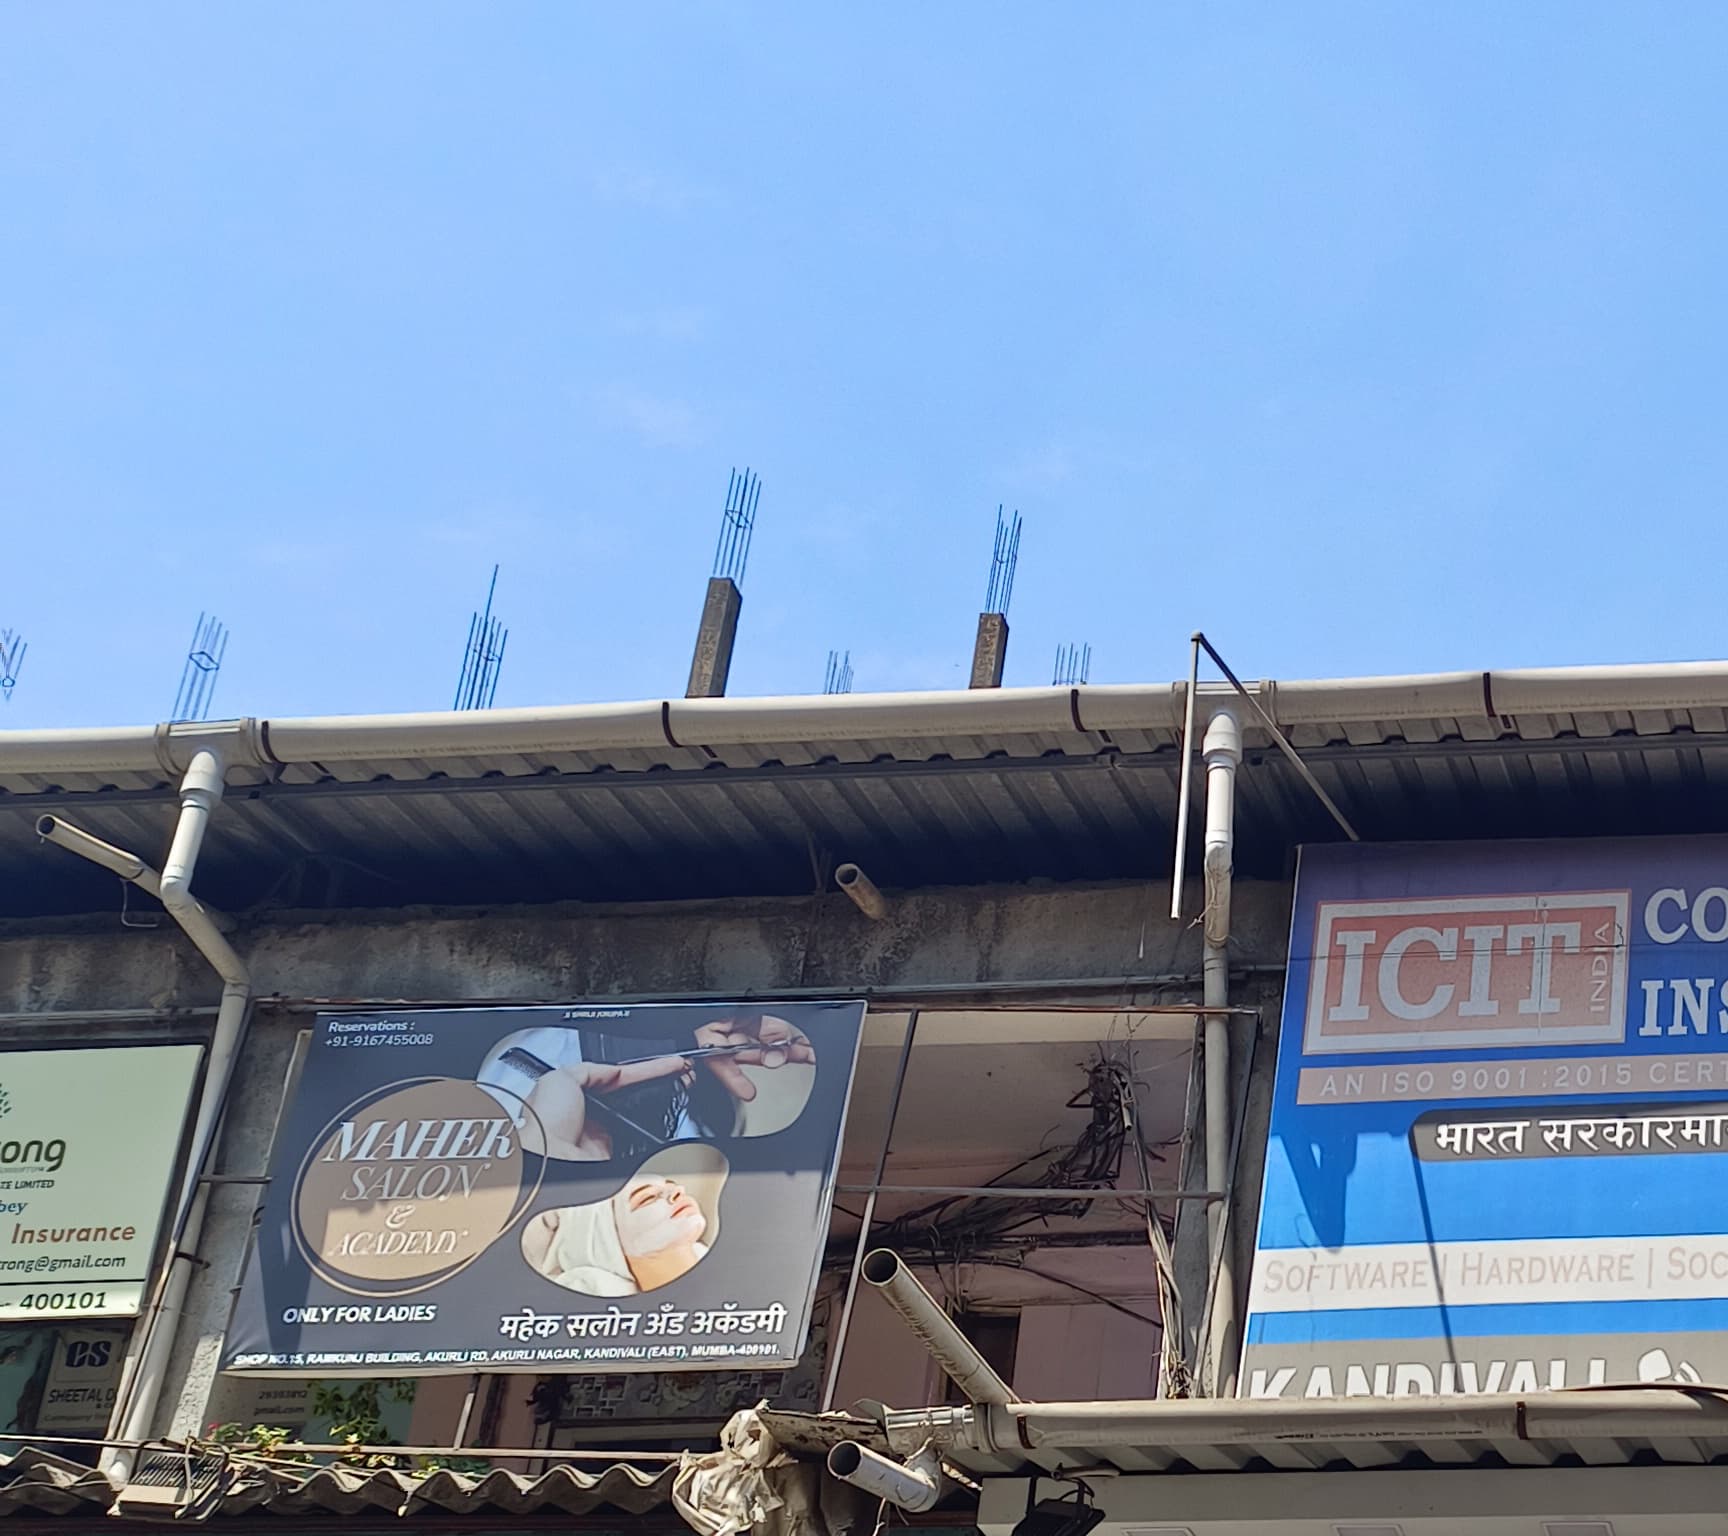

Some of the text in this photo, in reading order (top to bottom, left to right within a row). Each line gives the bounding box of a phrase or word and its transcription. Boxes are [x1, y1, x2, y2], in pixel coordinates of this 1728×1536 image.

[1328, 921, 1582, 1022] ICIT
[1589, 921, 1610, 1013] INDIA
[328, 1020, 407, 1033] Reservations
[1320, 1073, 1365, 1097] AN
[1381, 1069, 1435, 1095] ISO
[1434, 1119, 1530, 1156] भारत
[0, 1139, 66, 1172] ong
[340, 1162, 491, 1202] SALON
[385, 1204, 415, 1229] &
[12, 1223, 136, 1245] Insurance
[19, 1292, 108, 1311] 400101
[282, 1305, 436, 1324] ONLY FOR LADIES
[499, 1307, 562, 1342] महेक
[567, 1306, 642, 1339] सलोन
